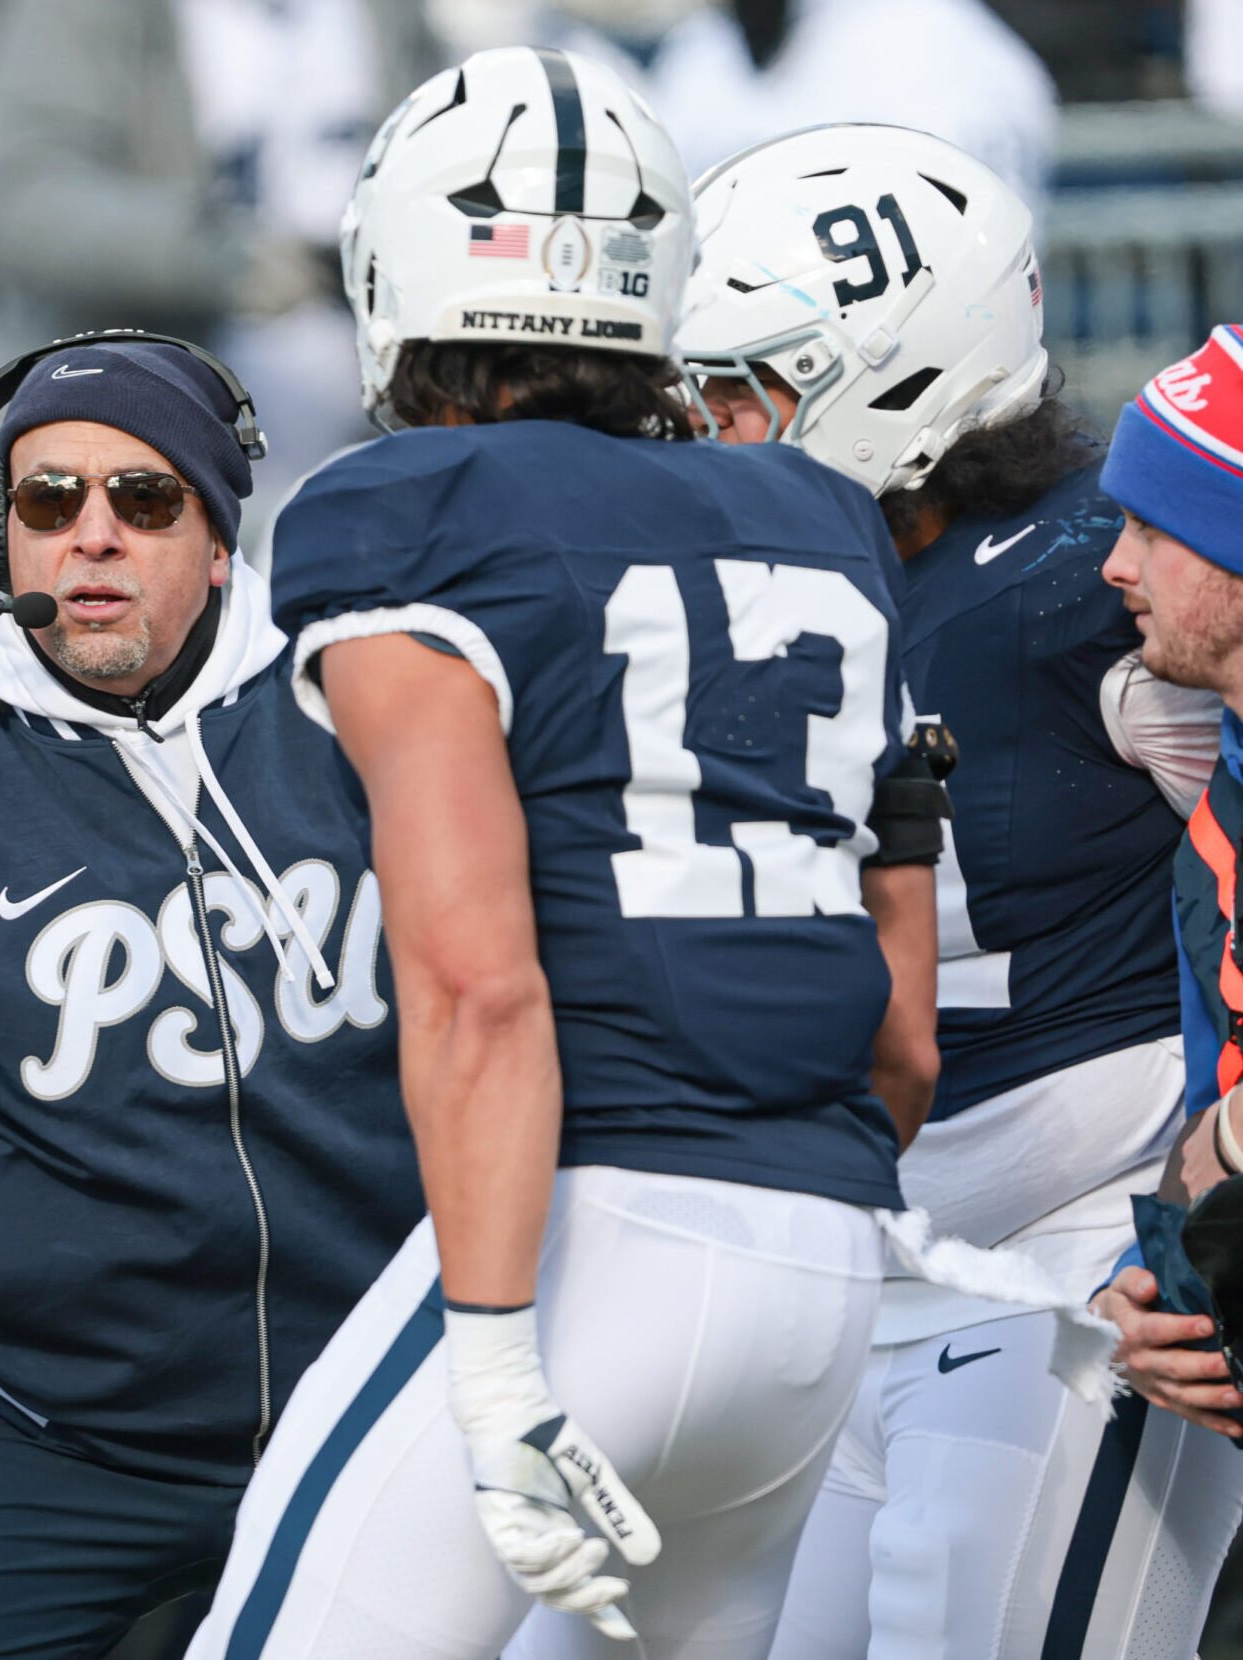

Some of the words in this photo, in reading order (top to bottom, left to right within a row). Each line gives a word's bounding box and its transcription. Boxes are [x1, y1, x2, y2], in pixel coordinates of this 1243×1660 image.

[462, 311, 574, 335] NITTANY
[812, 192, 933, 308] 91
[603, 558, 889, 919] 13
[20, 858, 389, 1101] PSU
